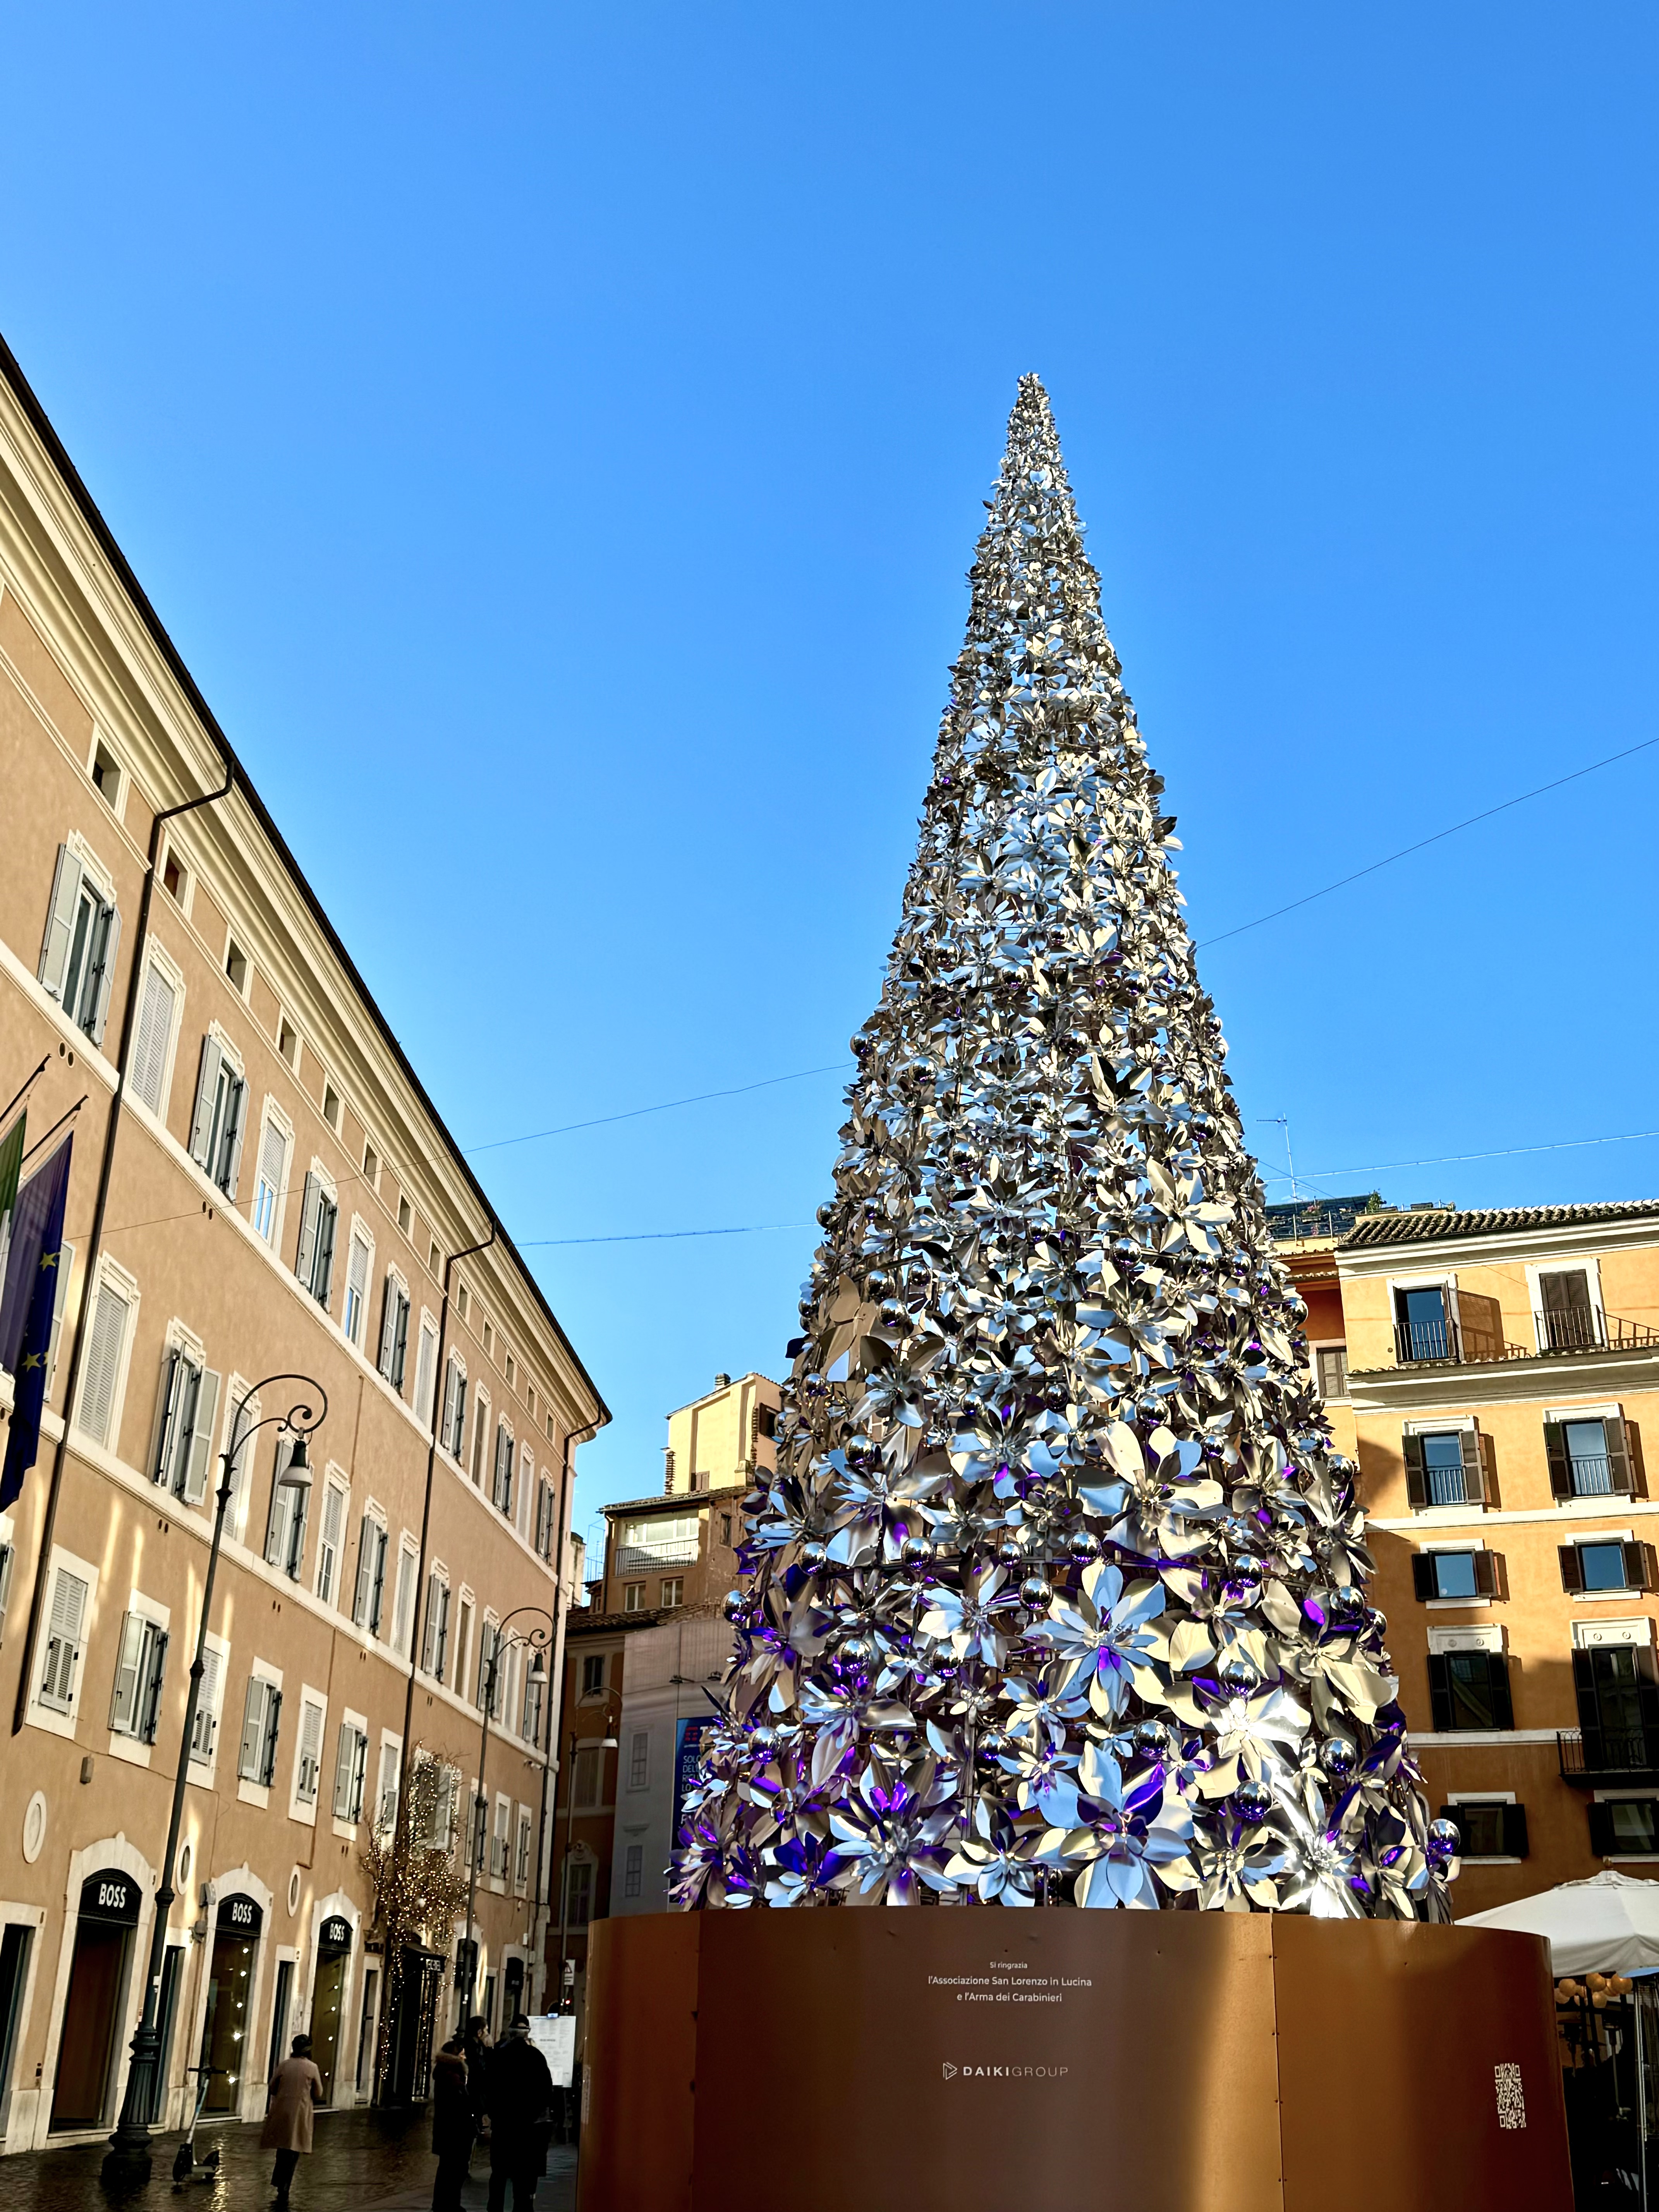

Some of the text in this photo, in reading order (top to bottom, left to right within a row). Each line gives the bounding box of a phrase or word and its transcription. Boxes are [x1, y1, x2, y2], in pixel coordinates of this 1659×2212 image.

[98, 1883, 126, 1908] BOSS
[232, 1902, 252, 1923] BOSS
[330, 1923, 345, 1941] BOSS
[998, 1961, 1027, 1970] ringrazia
[928, 1976, 1092, 1986] l'Associazione San Lorenzo in Lucina
[965, 1992, 993, 2001] l'Arma
[996, 1993, 1010, 2001] dei
[1012, 1993, 1062, 2002] Carabinieri
